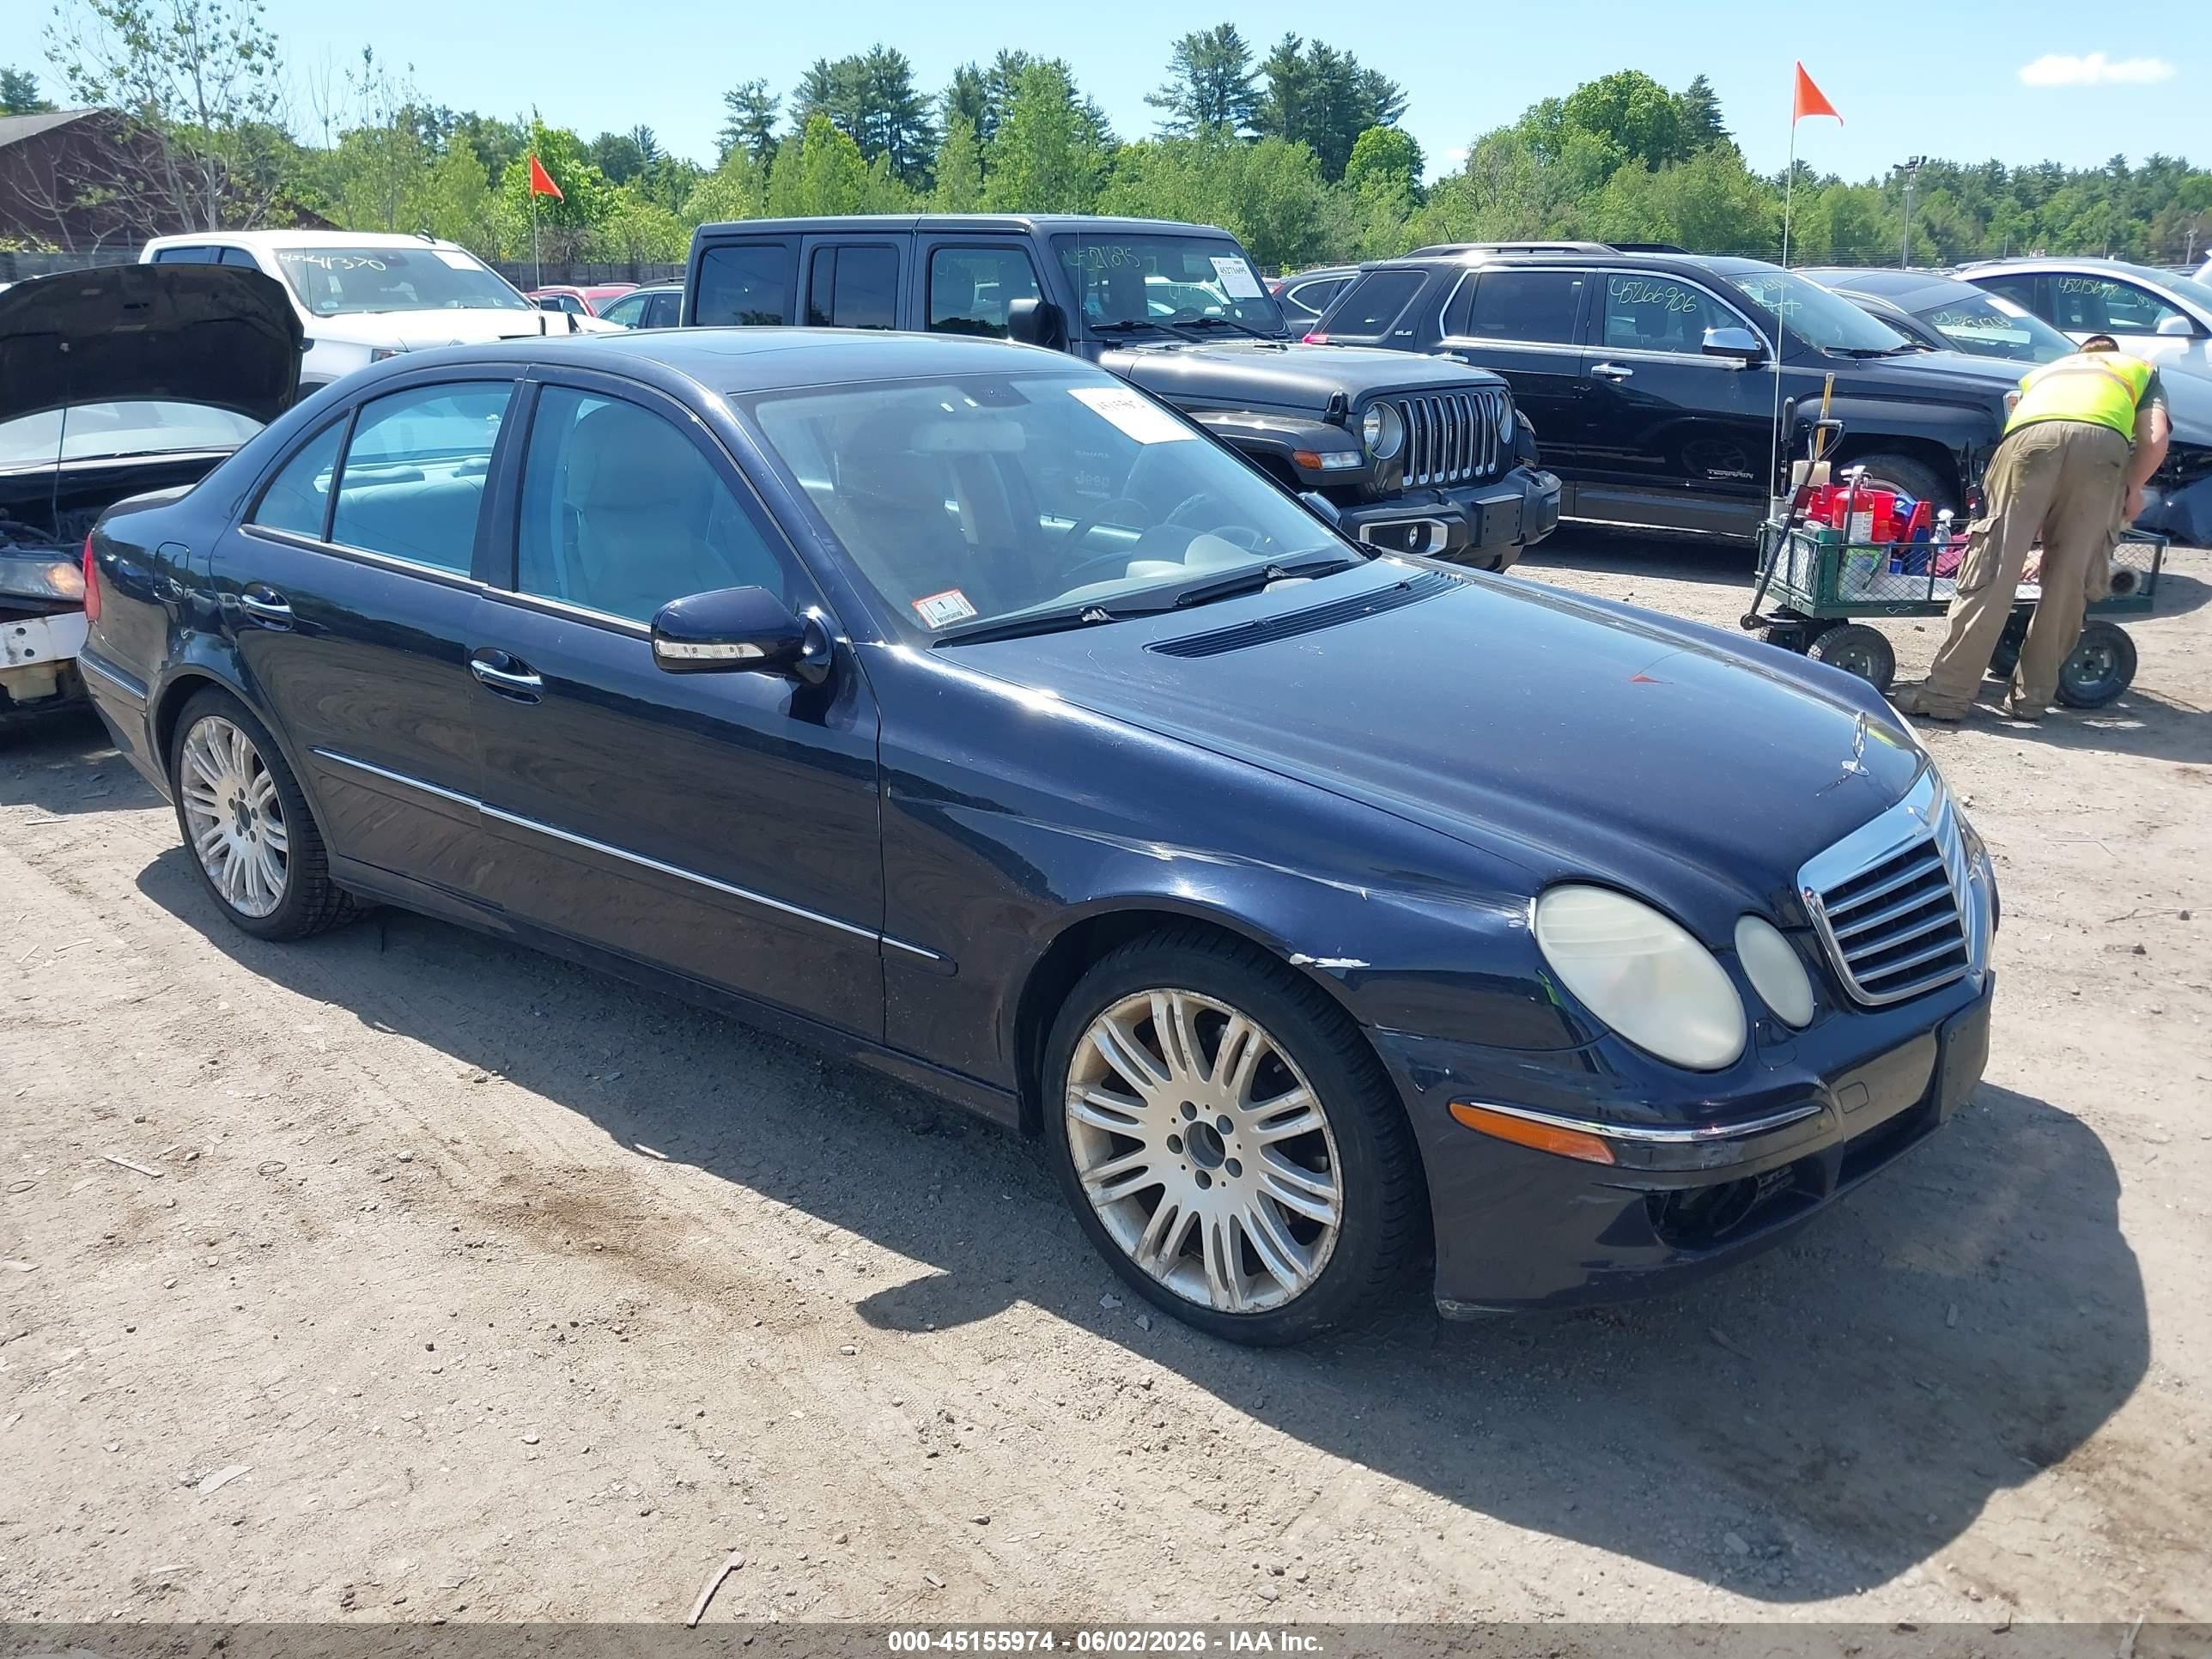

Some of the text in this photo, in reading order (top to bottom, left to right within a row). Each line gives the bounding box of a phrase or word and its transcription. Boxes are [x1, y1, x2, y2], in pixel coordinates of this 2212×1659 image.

[1610, 278, 1698, 313] 45266906
[1074, 470, 1111, 488] Jeep
[937, 600, 946, 610] 1
